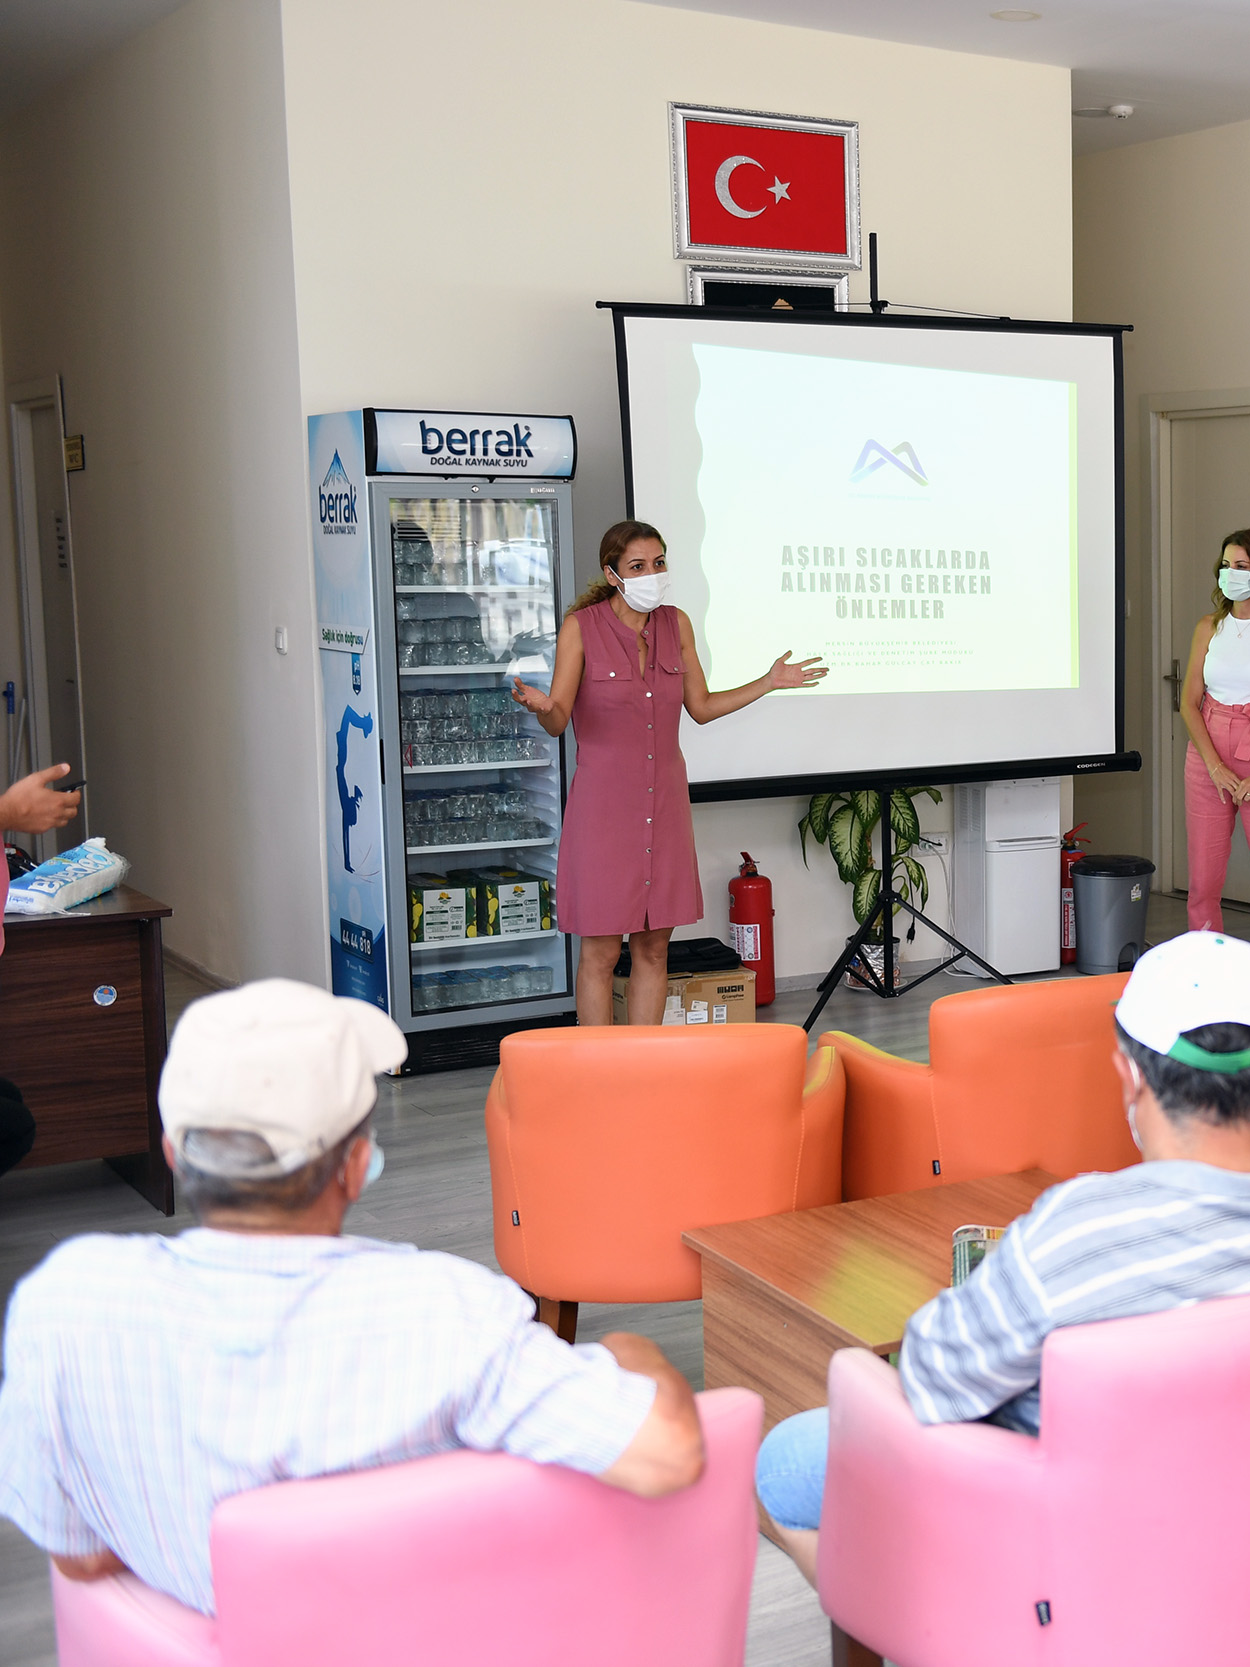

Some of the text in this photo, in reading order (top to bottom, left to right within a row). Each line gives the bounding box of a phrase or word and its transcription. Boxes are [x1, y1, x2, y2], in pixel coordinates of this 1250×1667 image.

[419, 419, 534, 458] berrak
[430, 455, 528, 468] DOĞAL KAYNAK SUYU
[319, 484, 358, 523] berrak
[781, 545, 990, 570] AŞIRI SICAKLARDA
[781, 572, 991, 594] ALINMASI GEREKEN
[835, 596, 945, 619] ÖNLEMLER
[360, 937, 371, 955] 818
